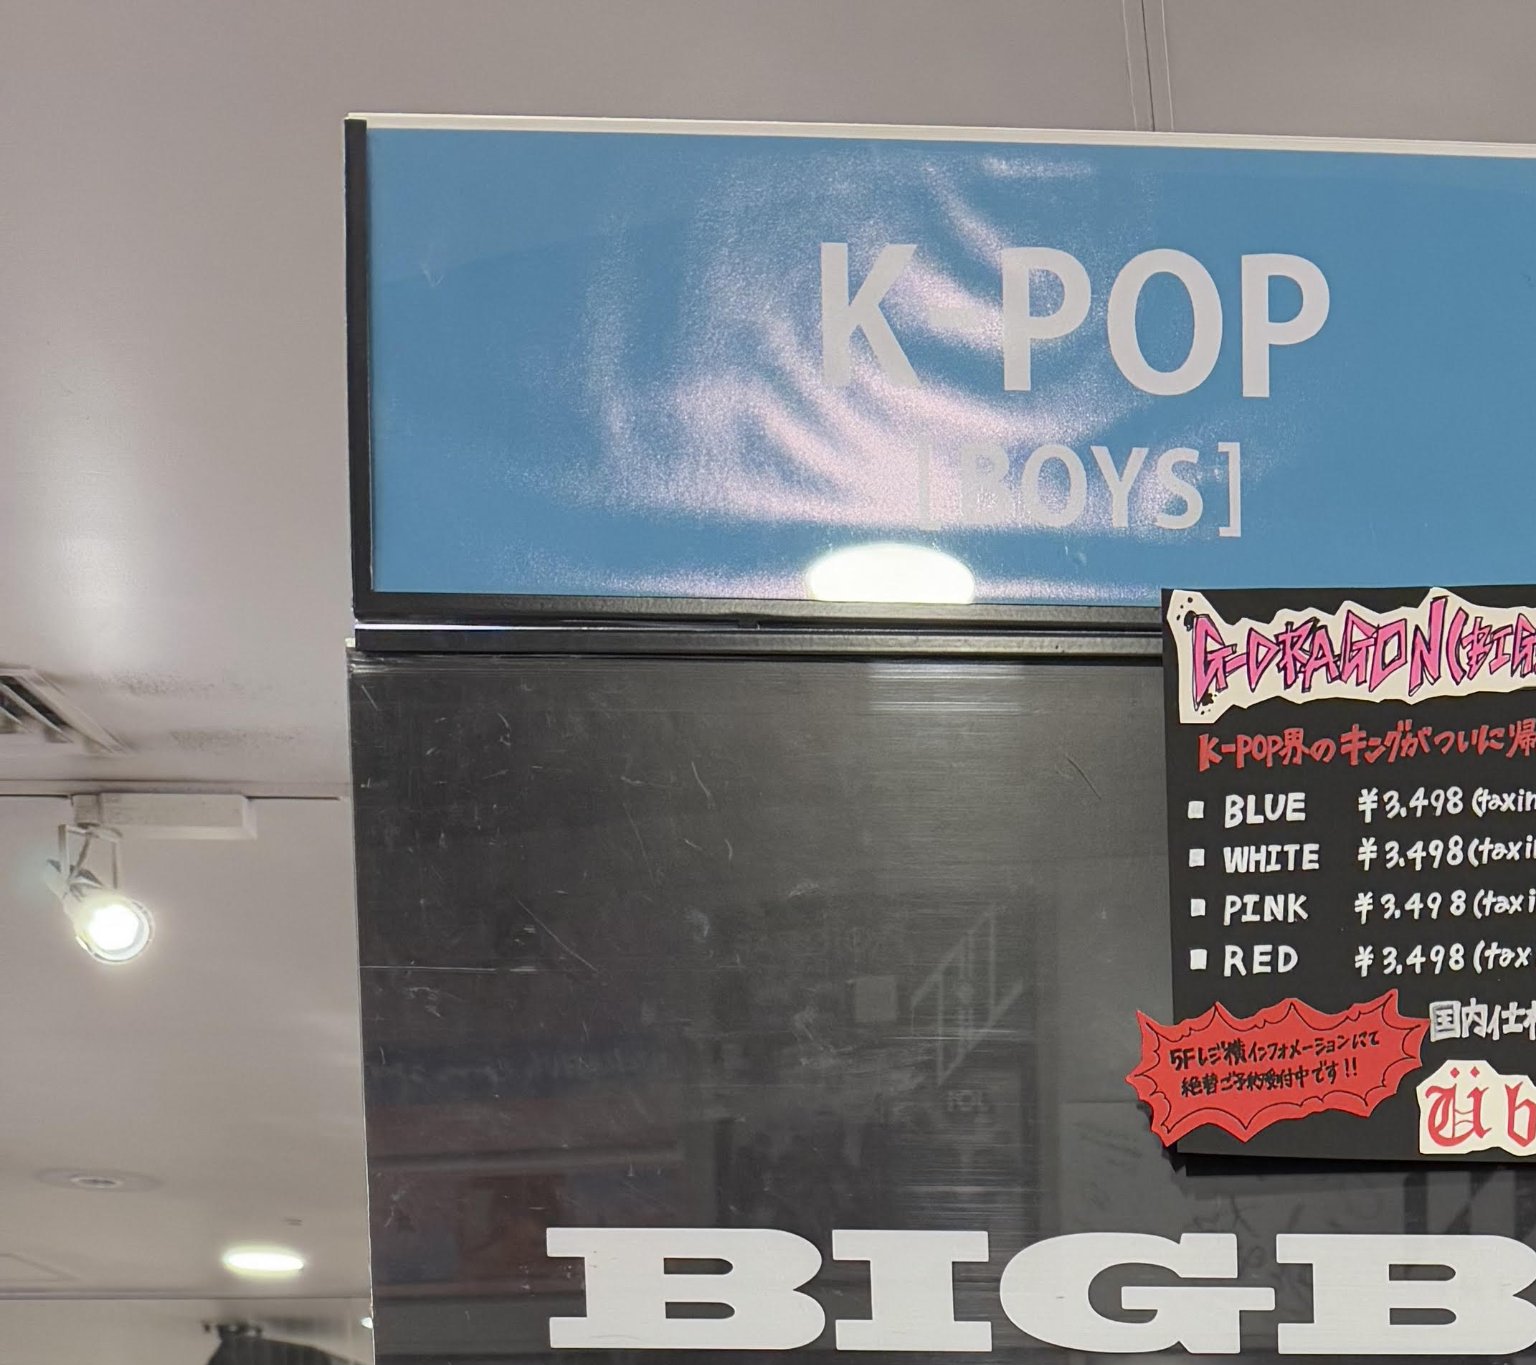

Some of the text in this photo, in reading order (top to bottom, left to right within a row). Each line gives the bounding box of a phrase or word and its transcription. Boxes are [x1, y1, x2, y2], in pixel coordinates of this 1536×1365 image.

[1223, 792, 1306, 829] BLUE
[1223, 843, 1320, 873] WHITE
[1223, 893, 1309, 926] PINK
[1223, 945, 1299, 977] RED
